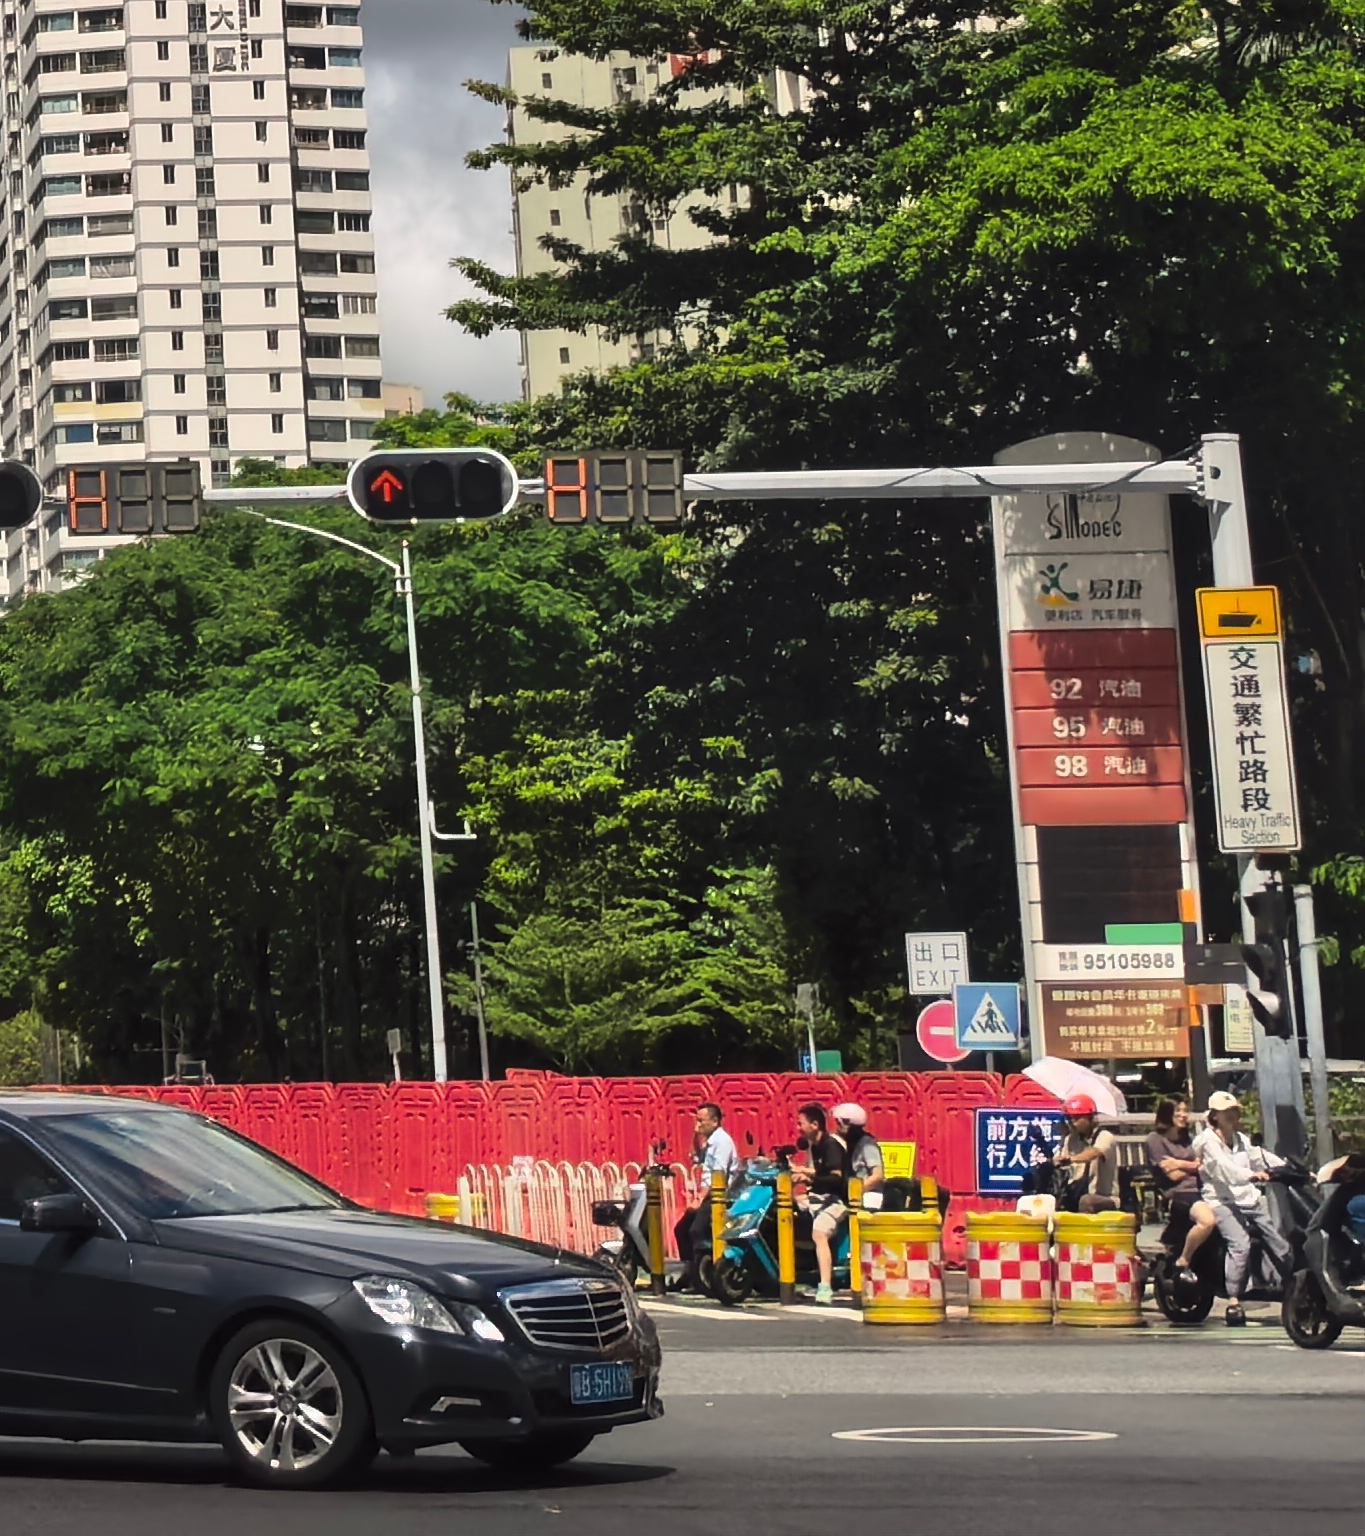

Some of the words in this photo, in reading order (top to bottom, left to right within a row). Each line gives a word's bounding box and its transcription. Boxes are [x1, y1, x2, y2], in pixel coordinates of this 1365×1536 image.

[1089, 578, 1142, 600] 易捷
[1050, 677, 1083, 699] 92
[1099, 679, 1142, 698] 汽油
[1052, 716, 1086, 738] 95
[1102, 716, 1145, 735] 汽油
[1228, 645, 1272, 812] 交通繁忙路段
[1054, 755, 1088, 777] 98
[1104, 755, 1147, 775] 汽油
[1224, 815, 1256, 831] Heavy
[1260, 812, 1291, 827] Traffic
[1241, 830, 1280, 844] Section
[914, 942, 960, 962] 出口
[1084, 953, 1175, 970] 95105988
[917, 970, 959, 986] EXIT
